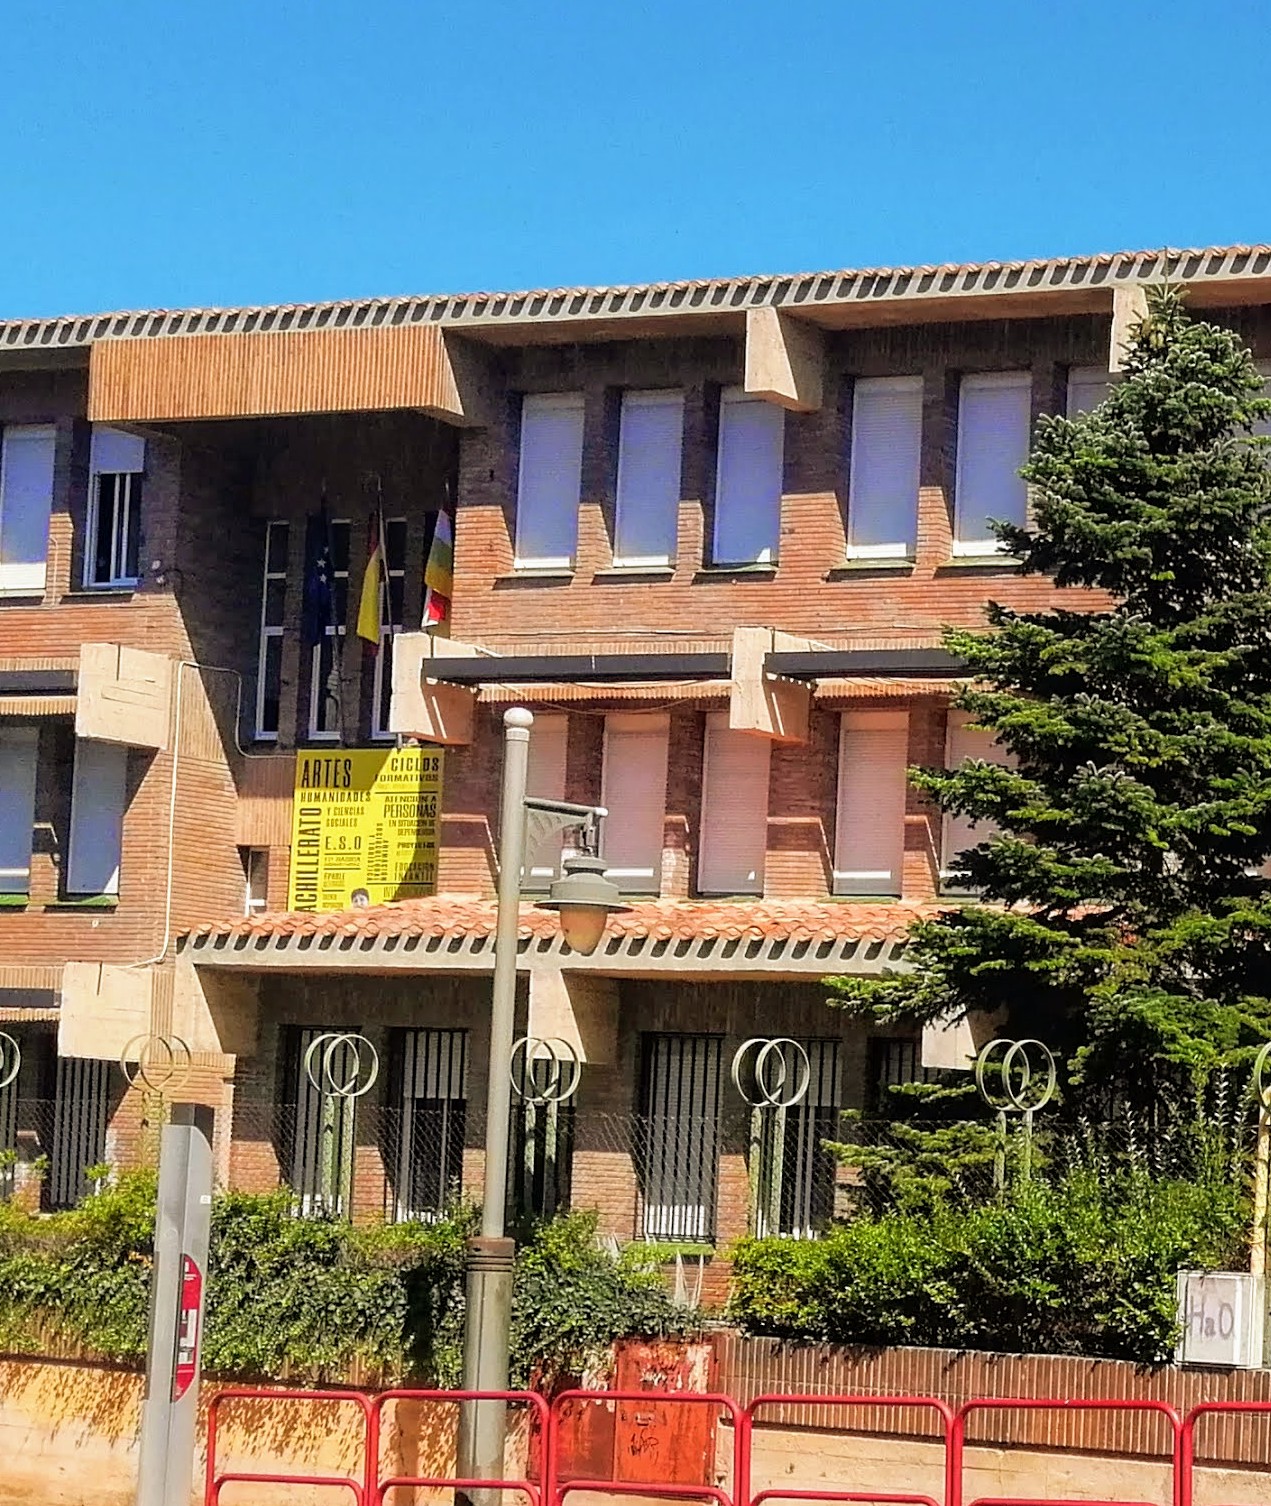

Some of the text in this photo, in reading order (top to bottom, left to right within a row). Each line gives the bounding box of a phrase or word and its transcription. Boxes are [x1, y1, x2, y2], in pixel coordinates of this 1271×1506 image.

[391, 757, 439, 772] CICLOS
[301, 758, 352, 788] ARTES
[300, 791, 371, 803] HUMANIDADES
[334, 806, 364, 816] CIENCIAS
[384, 804, 436, 818] PERSONAS
[326, 818, 357, 827] SOCIALES
[294, 808, 322, 913] ACHILLERATO
